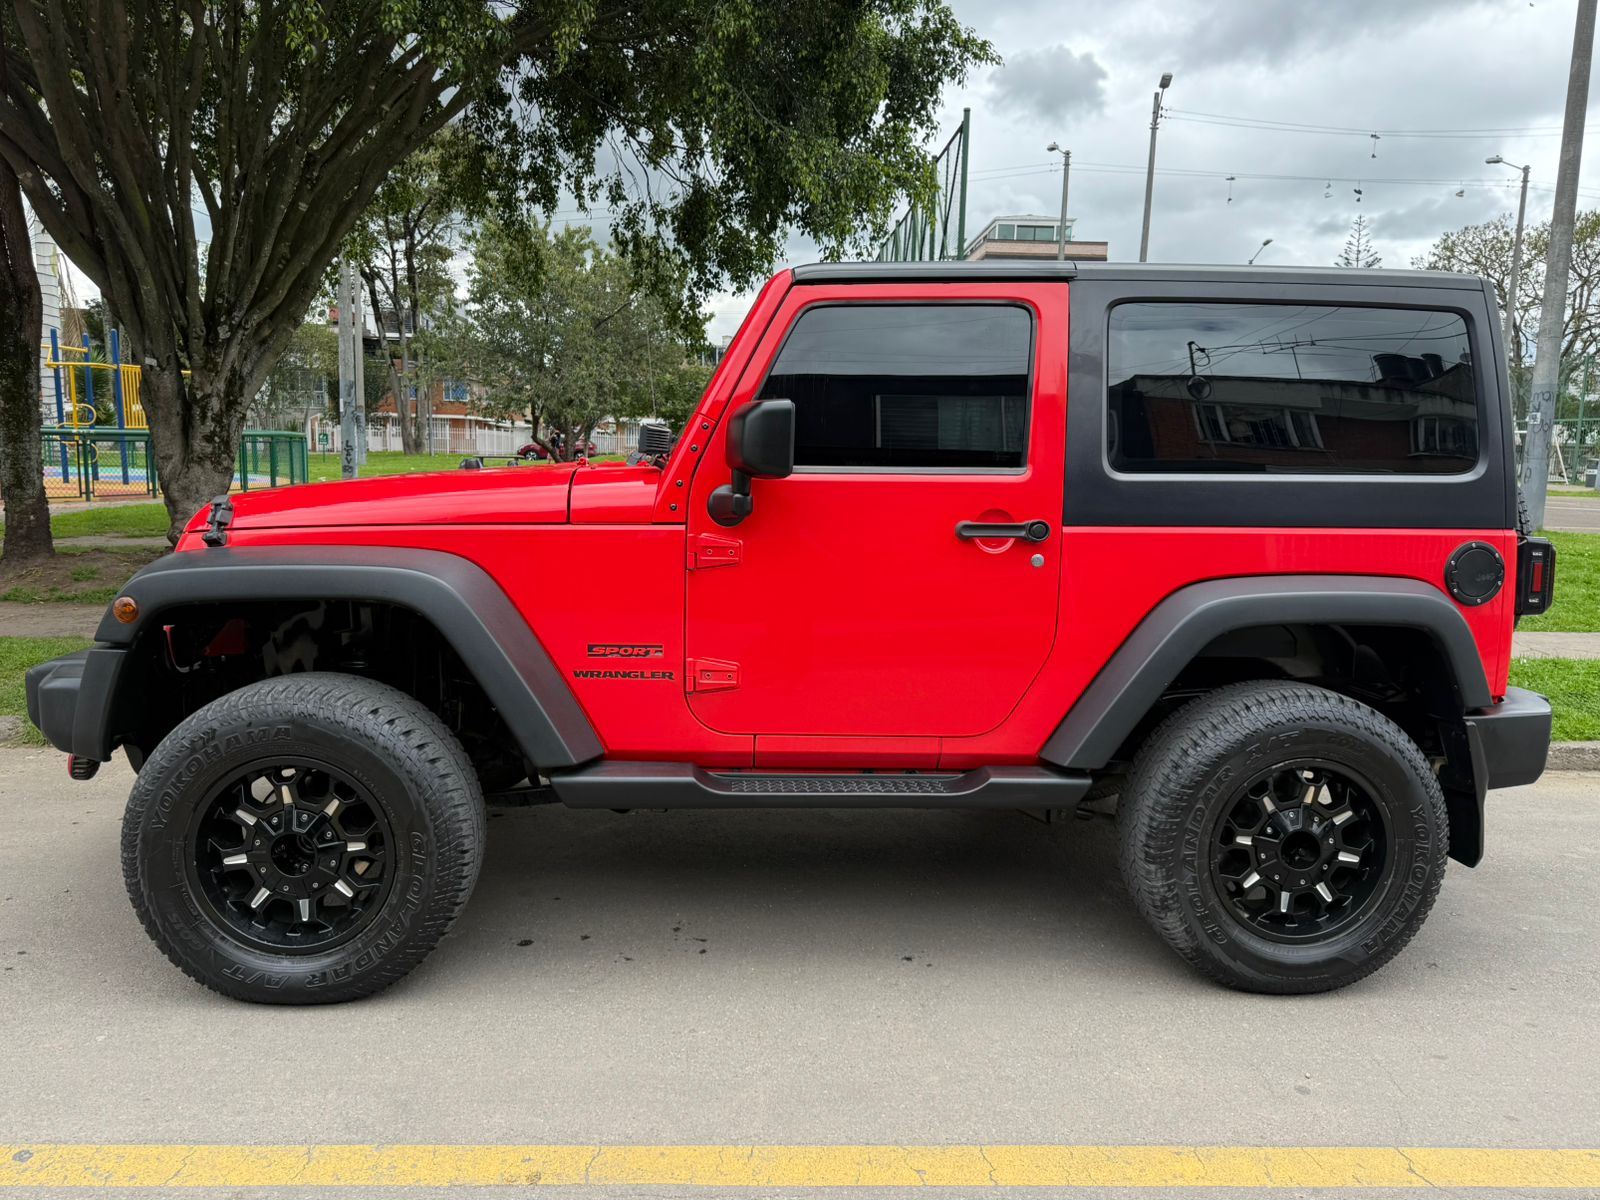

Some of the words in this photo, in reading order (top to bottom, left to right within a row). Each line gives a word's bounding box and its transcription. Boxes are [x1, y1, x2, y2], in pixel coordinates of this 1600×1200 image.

[573, 670, 674, 680] WRANGLER
[590, 646, 661, 656] SPORT
[150, 726, 293, 829] YOKOHAMA
[1183, 765, 1234, 945] GEOLANDAR
[1360, 804, 1430, 954] YOKOHAMA
[303, 831, 426, 989] GEOLANDAR
[221, 966, 290, 989] A/T
